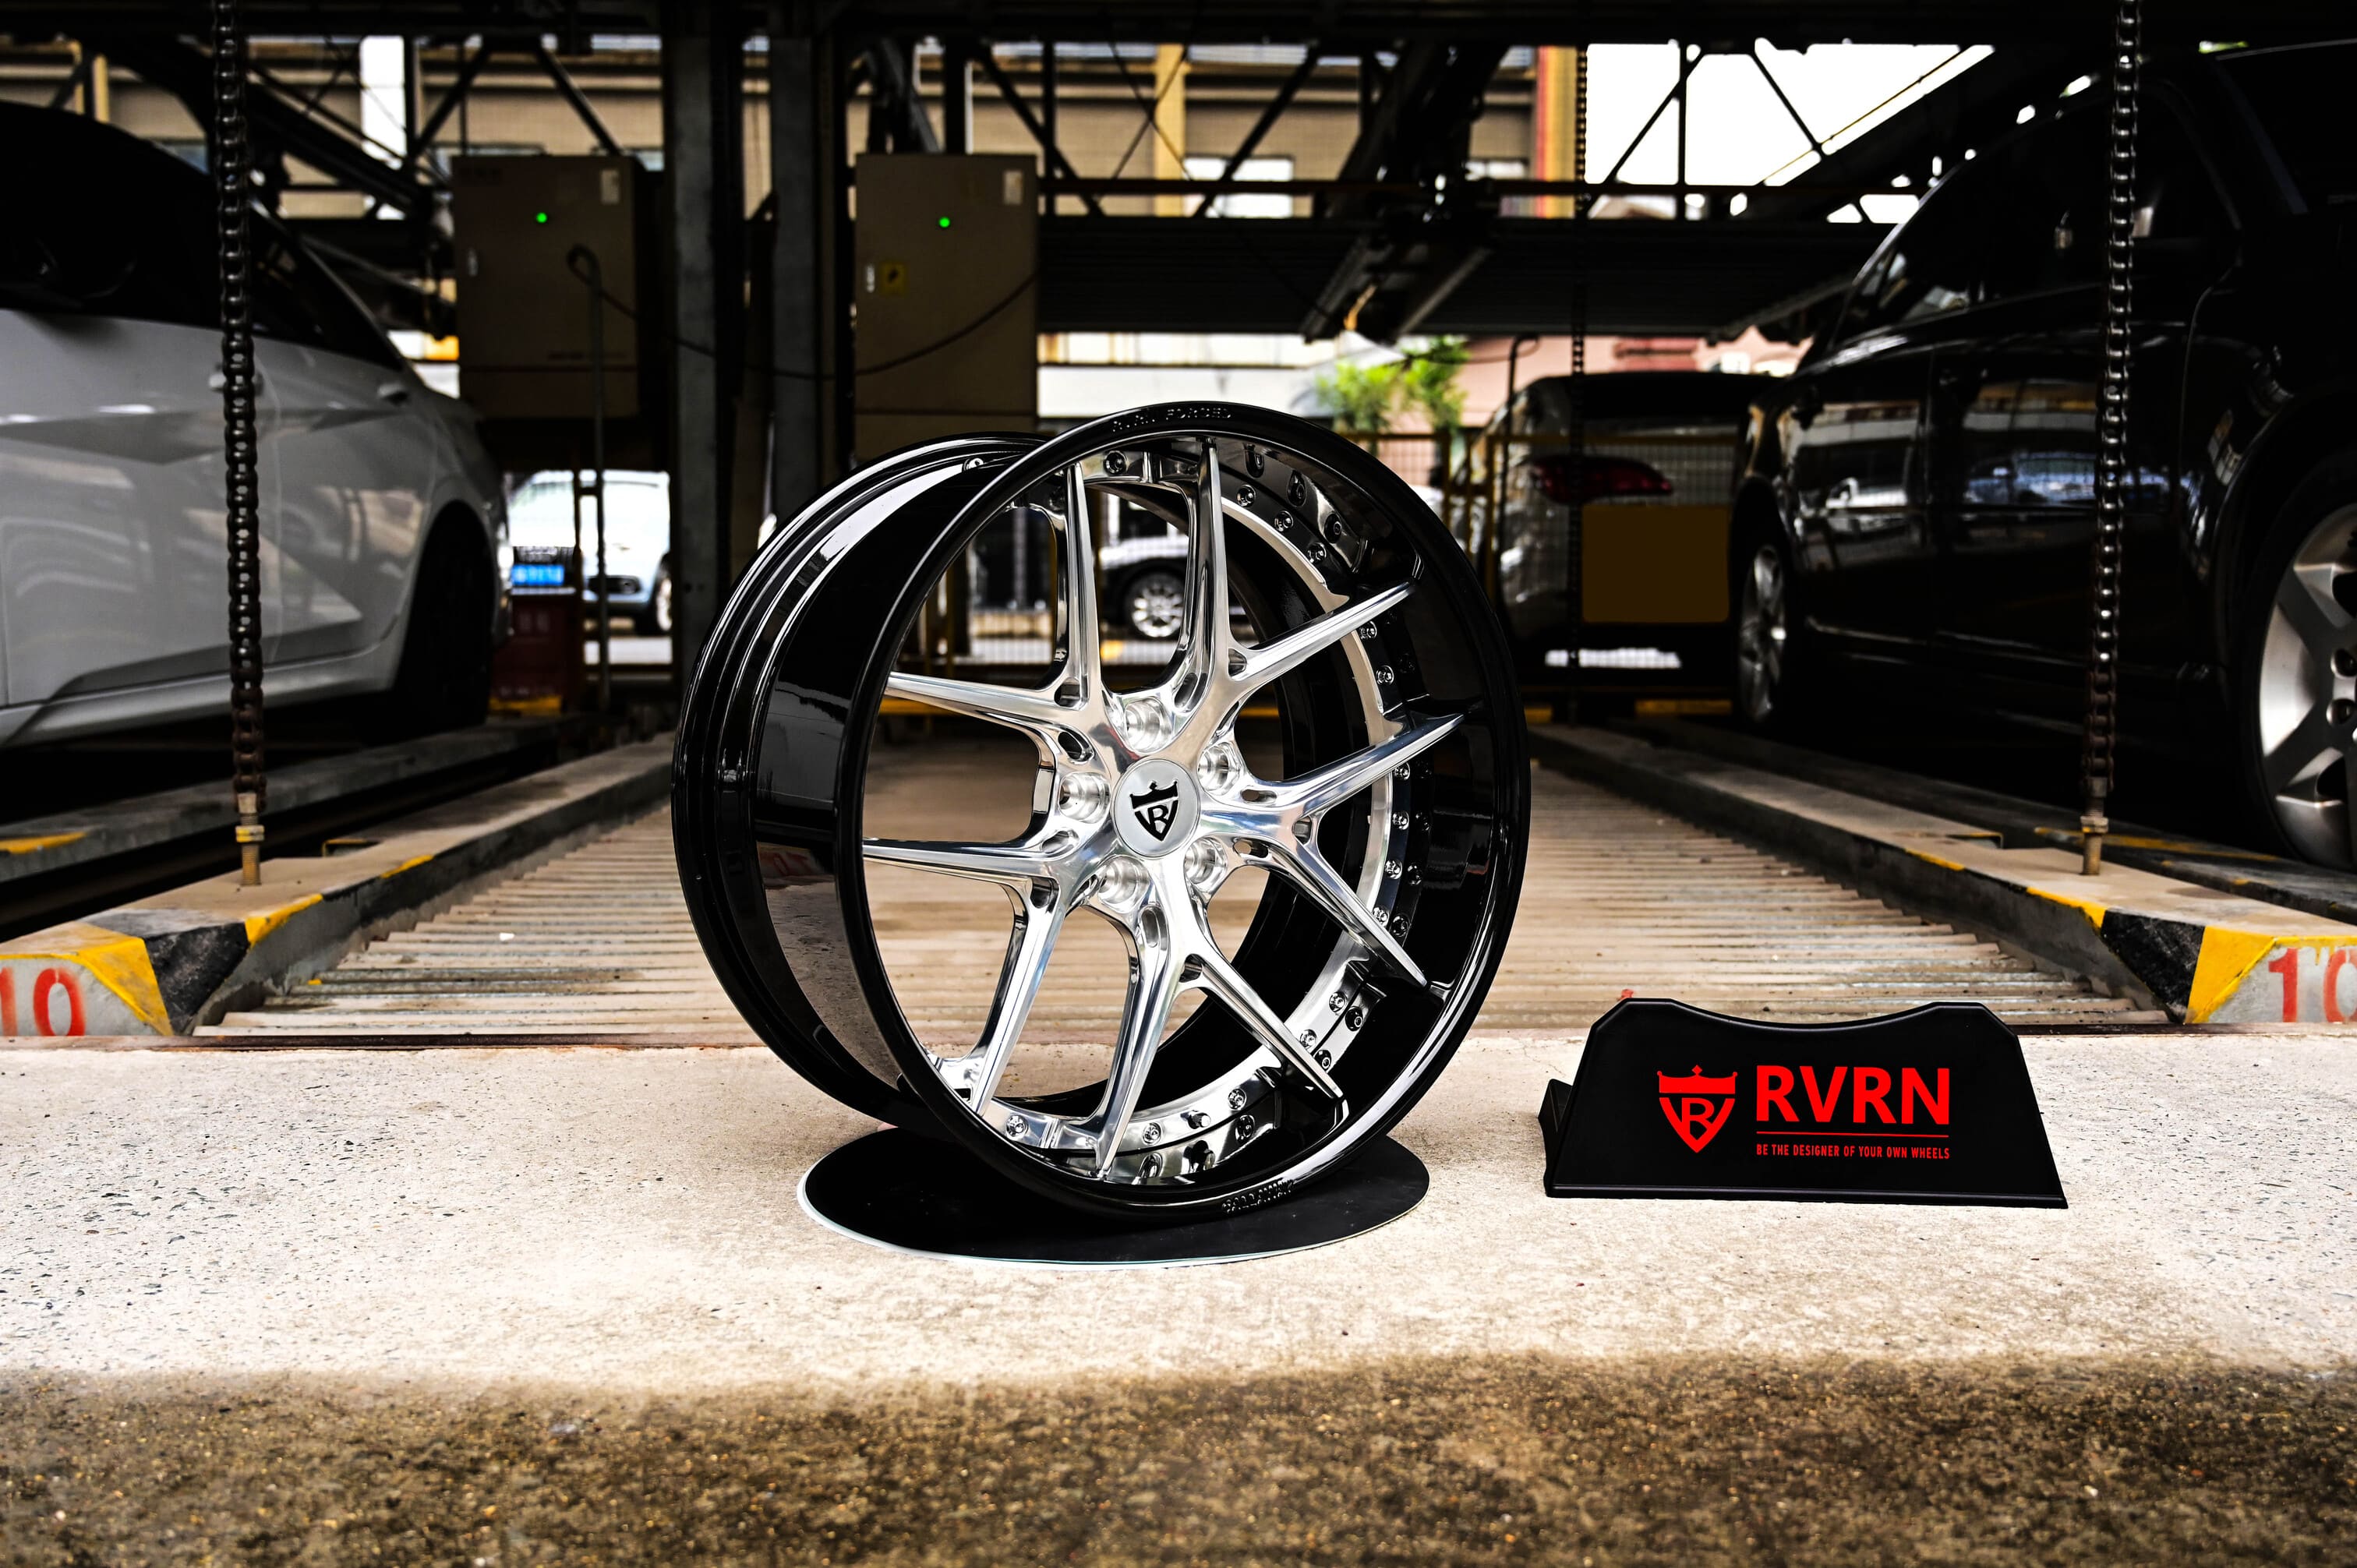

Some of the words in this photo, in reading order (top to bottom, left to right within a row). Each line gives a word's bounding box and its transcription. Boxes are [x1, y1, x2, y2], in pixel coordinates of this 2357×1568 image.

[0, 967, 86, 1036] 10
[2268, 948, 2357, 1023] 10
[1757, 1065, 1949, 1125] RVRN
[1756, 1143, 1769, 1156] BE
[1771, 1143, 1790, 1157] THE
[1793, 1144, 1840, 1157] DESIGNER
[1843, 1145, 1856, 1157] OF
[1858, 1146, 1883, 1158] YOUR
[1886, 1146, 1907, 1159] OWN
[1910, 1146, 1950, 1160] WHEELS
